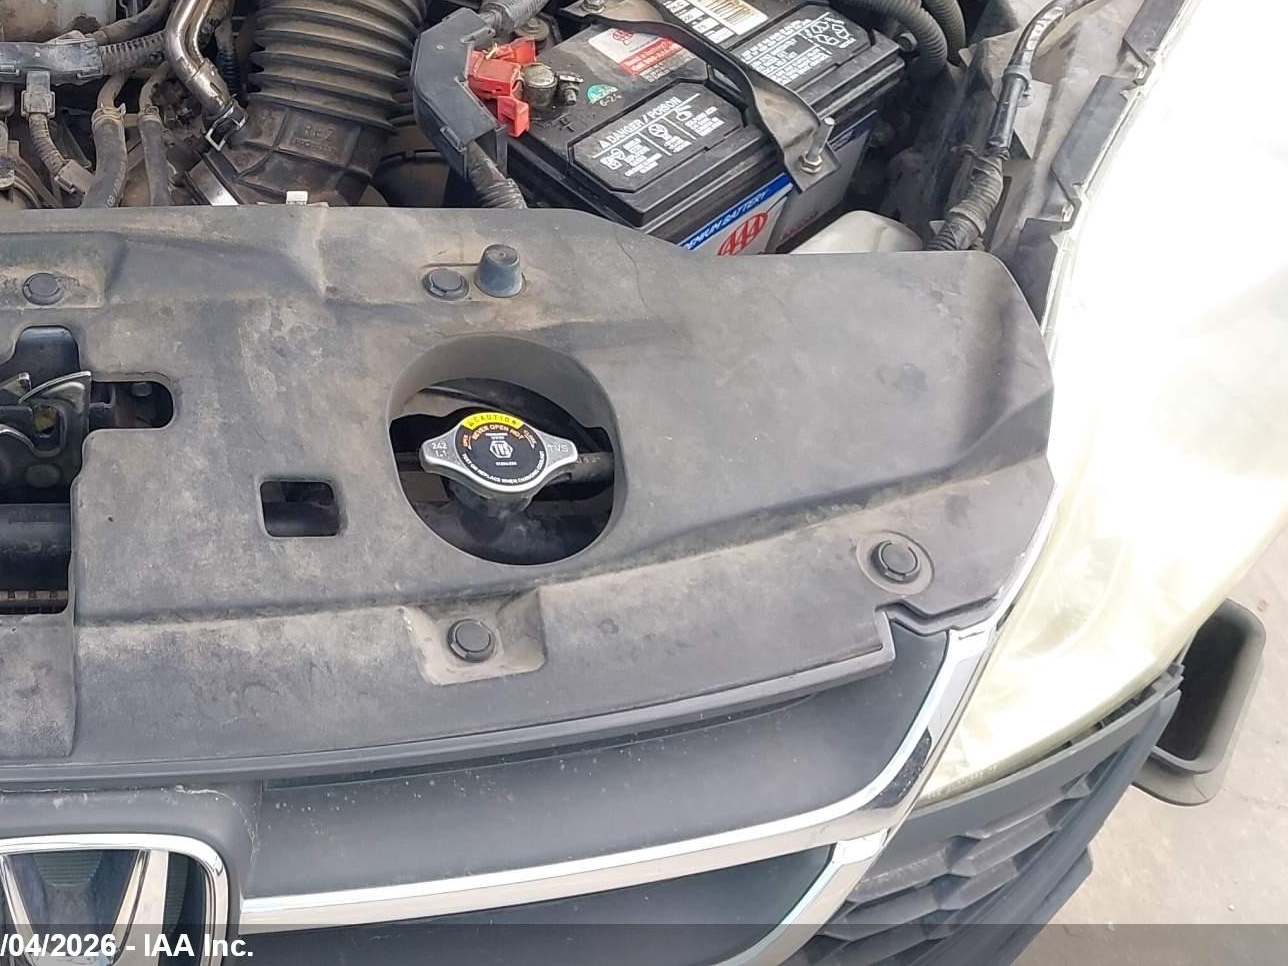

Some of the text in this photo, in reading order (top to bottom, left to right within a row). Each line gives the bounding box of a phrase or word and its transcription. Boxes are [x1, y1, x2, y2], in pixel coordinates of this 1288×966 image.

[606, 117, 645, 144] DANGER
[647, 96, 683, 120] POISON
[721, 189, 769, 226] BATTERY
[474, 415, 517, 426] CAUTION
[472, 425, 490, 440] NEVER
[489, 424, 509, 432] OPEN
[509, 428, 525, 440] HOT
[547, 444, 569, 453] TVS
[477, 469, 501, 483] REPLACE
